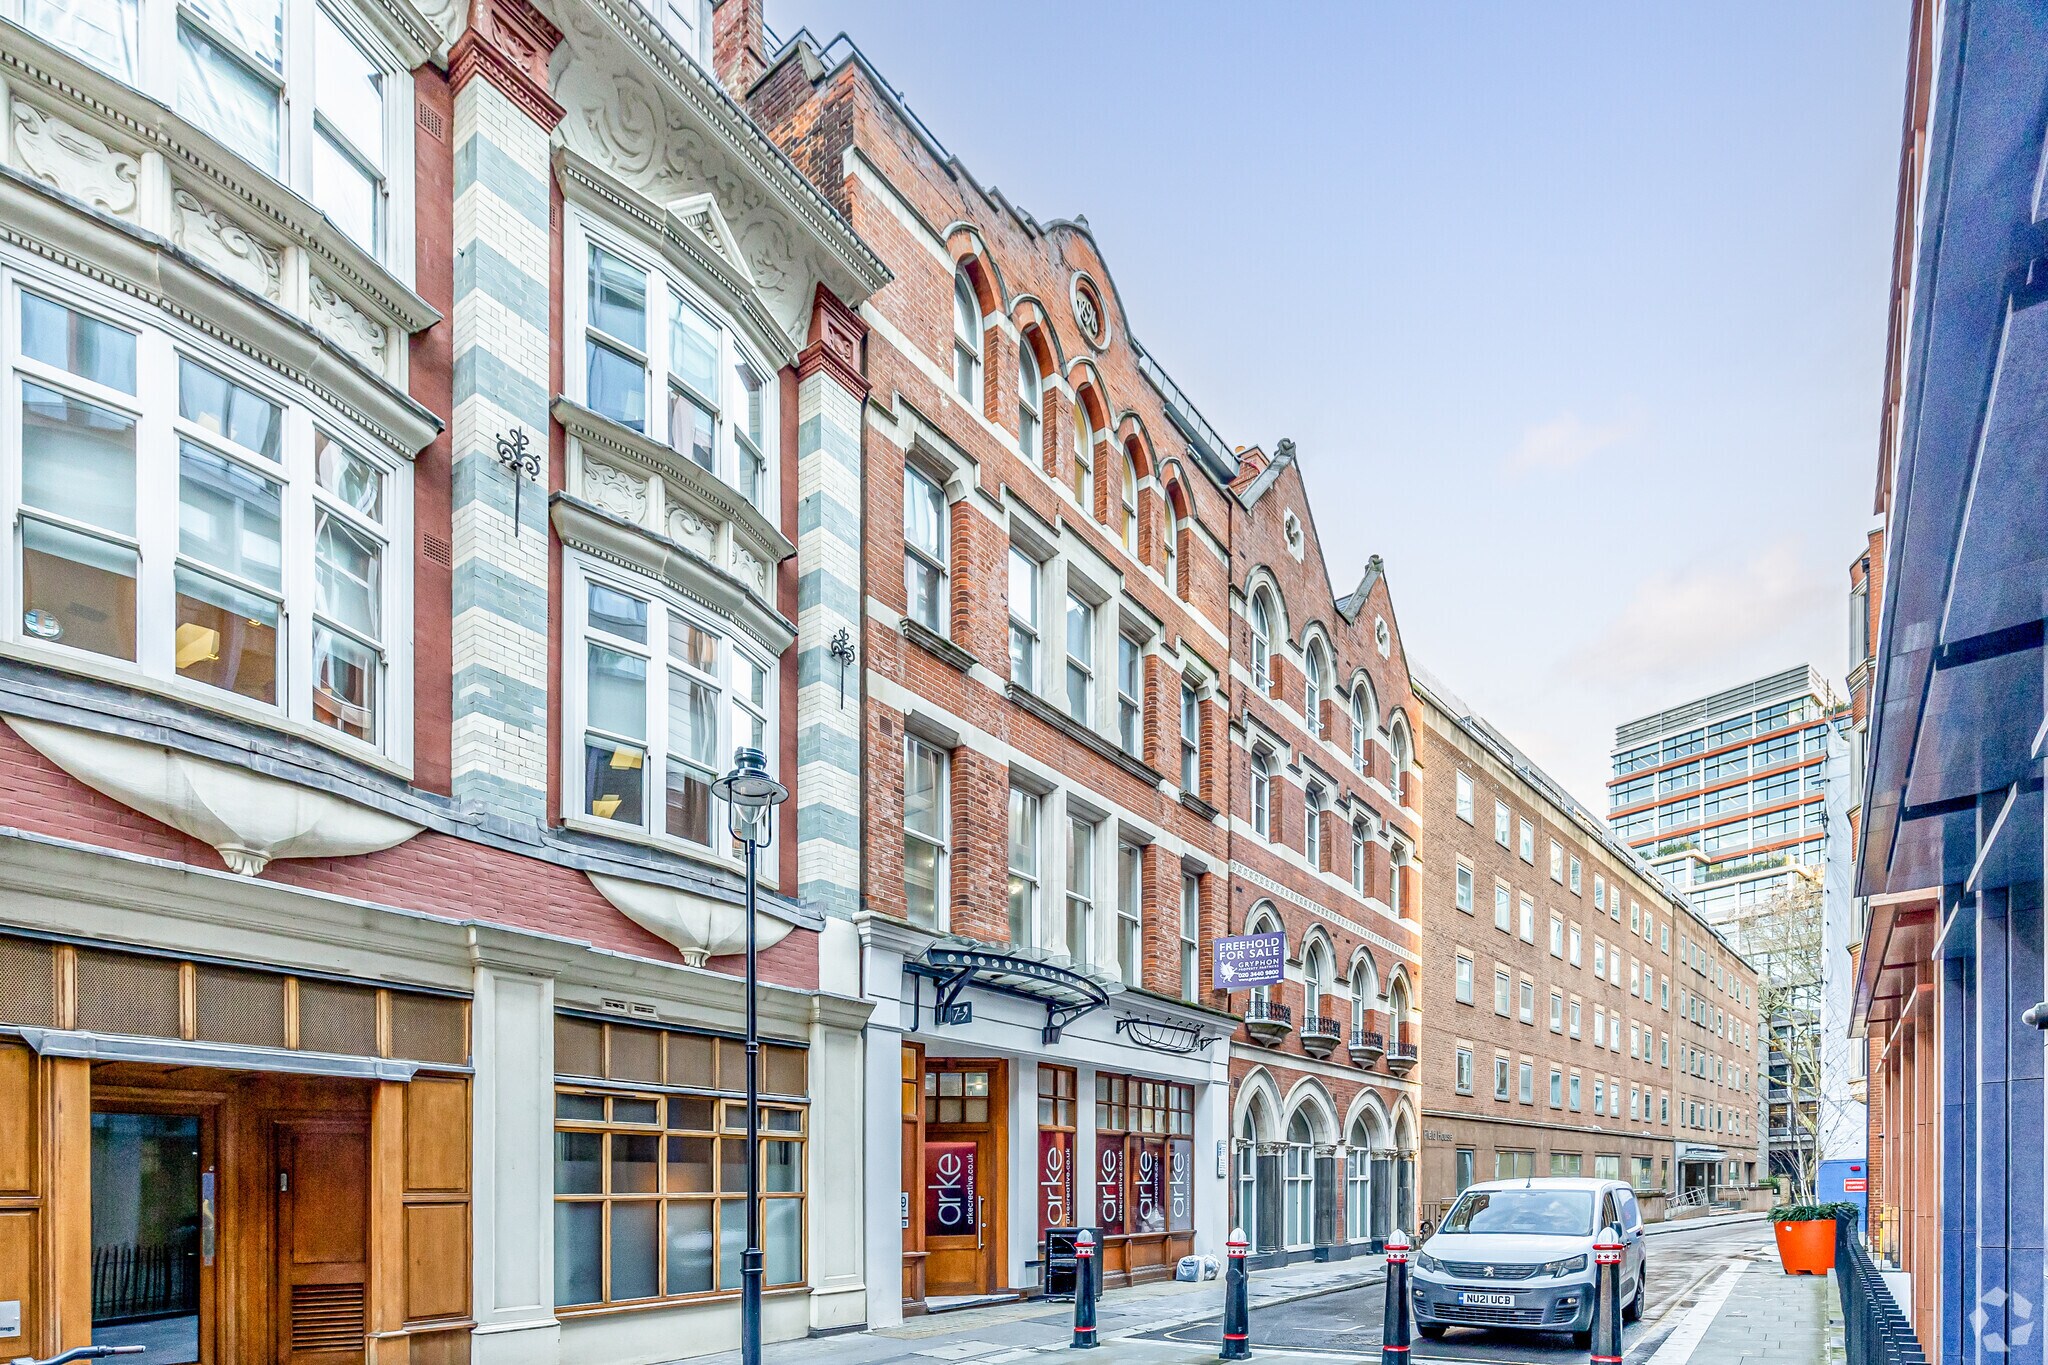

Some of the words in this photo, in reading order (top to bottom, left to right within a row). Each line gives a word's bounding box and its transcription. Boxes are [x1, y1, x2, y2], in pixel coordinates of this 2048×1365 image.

[1219, 937, 1280, 951] FREEHOLD
[1219, 950, 1245, 961] FOR
[1249, 946, 1280, 958] SALE
[1238, 958, 1279, 968] GRYPHON
[928, 1153, 961, 1225] arke
[966, 1153, 974, 1225] arkecreative.co.uk
[1040, 1147, 1063, 1225] arke
[1097, 1149, 1116, 1222] arke
[1135, 1151, 1152, 1219] arke
[1169, 1152, 1184, 1218] arke
[1466, 1294, 1489, 1304] NU21
[1490, 1296, 1511, 1304] UCB
